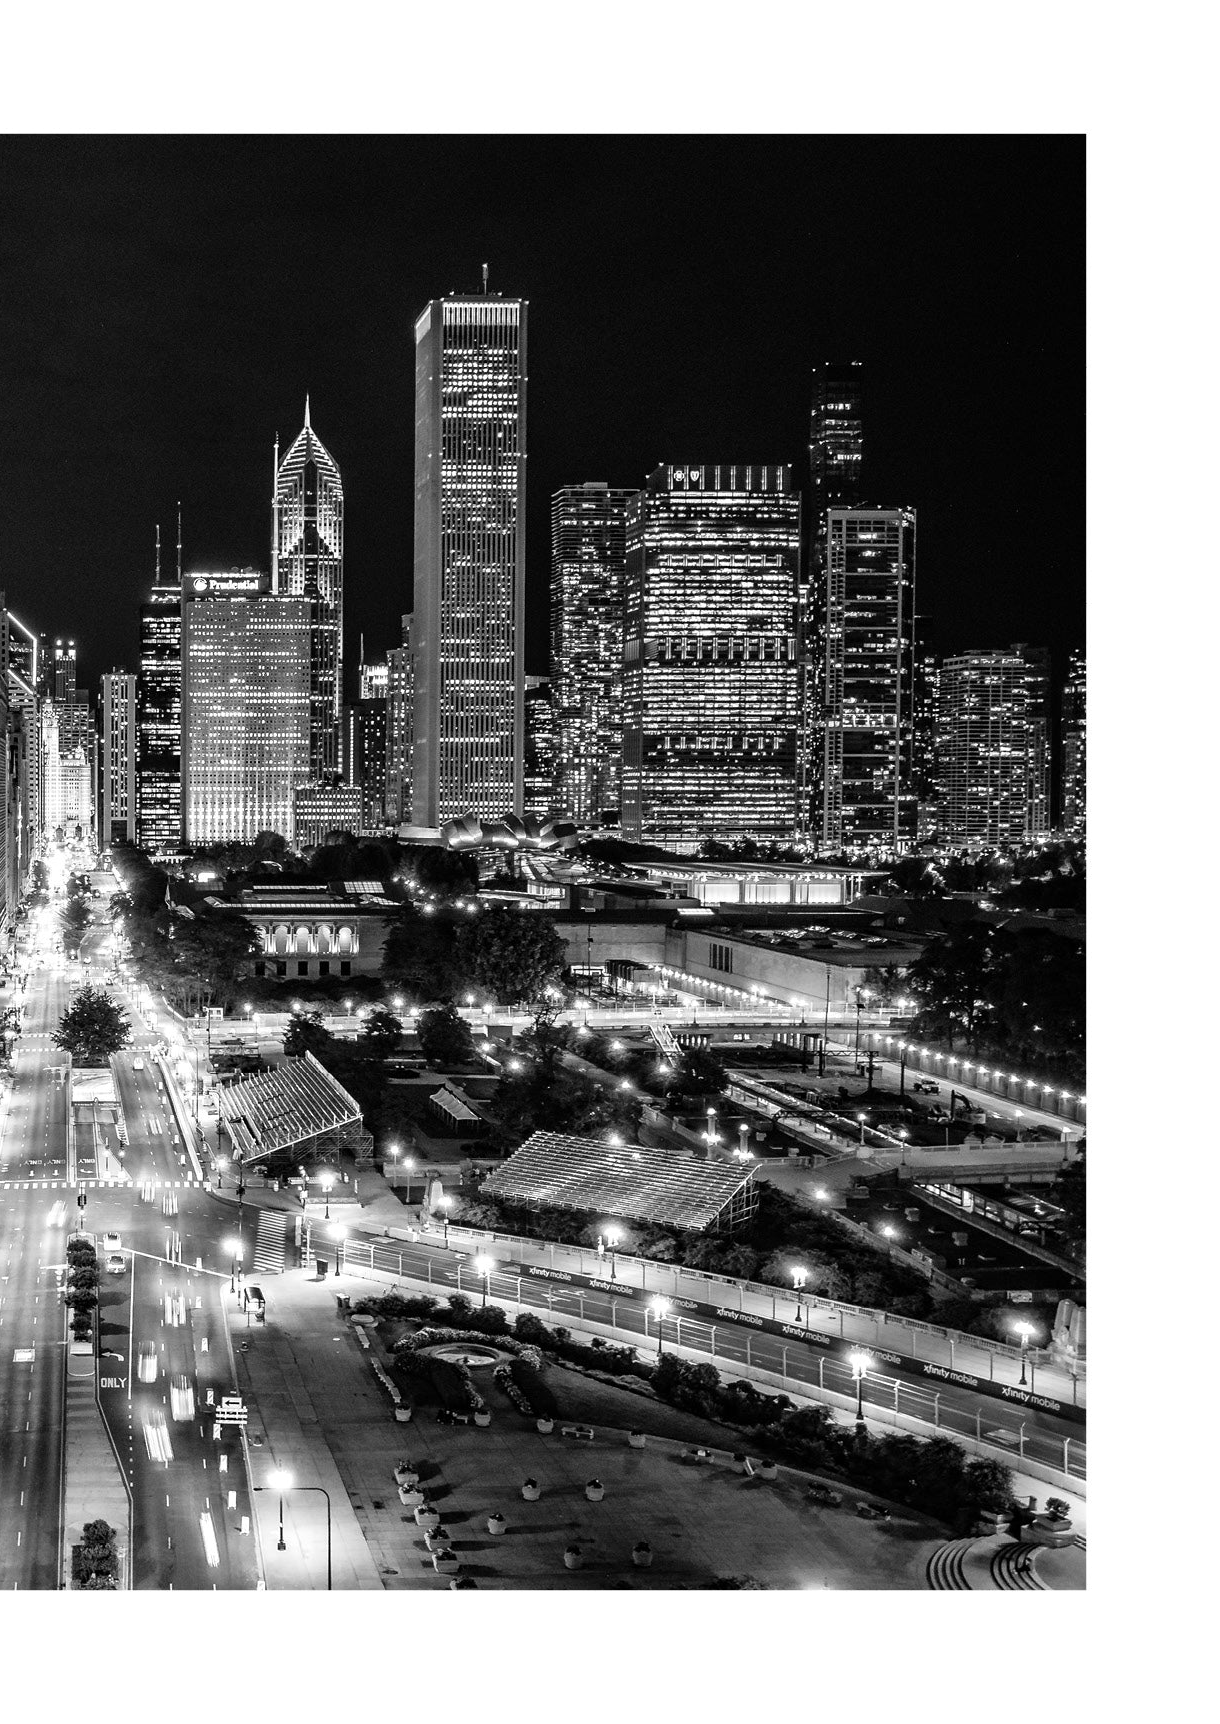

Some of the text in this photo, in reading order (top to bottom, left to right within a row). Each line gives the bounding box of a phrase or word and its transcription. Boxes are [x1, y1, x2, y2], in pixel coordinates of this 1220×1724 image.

[209, 579, 259, 590] Prudential
[529, 1266, 572, 1282] xfinity mobile
[589, 1279, 633, 1295] xfinity mobile
[716, 1307, 764, 1326] xfinity mobile
[782, 1325, 830, 1345] xfinity mobile
[875, 1351, 901, 1364] mobile
[100, 1377, 127, 1389] ONLY
[923, 1364, 978, 1387] xfinity mobile
[1002, 1386, 1061, 1412] xfinity mobile
